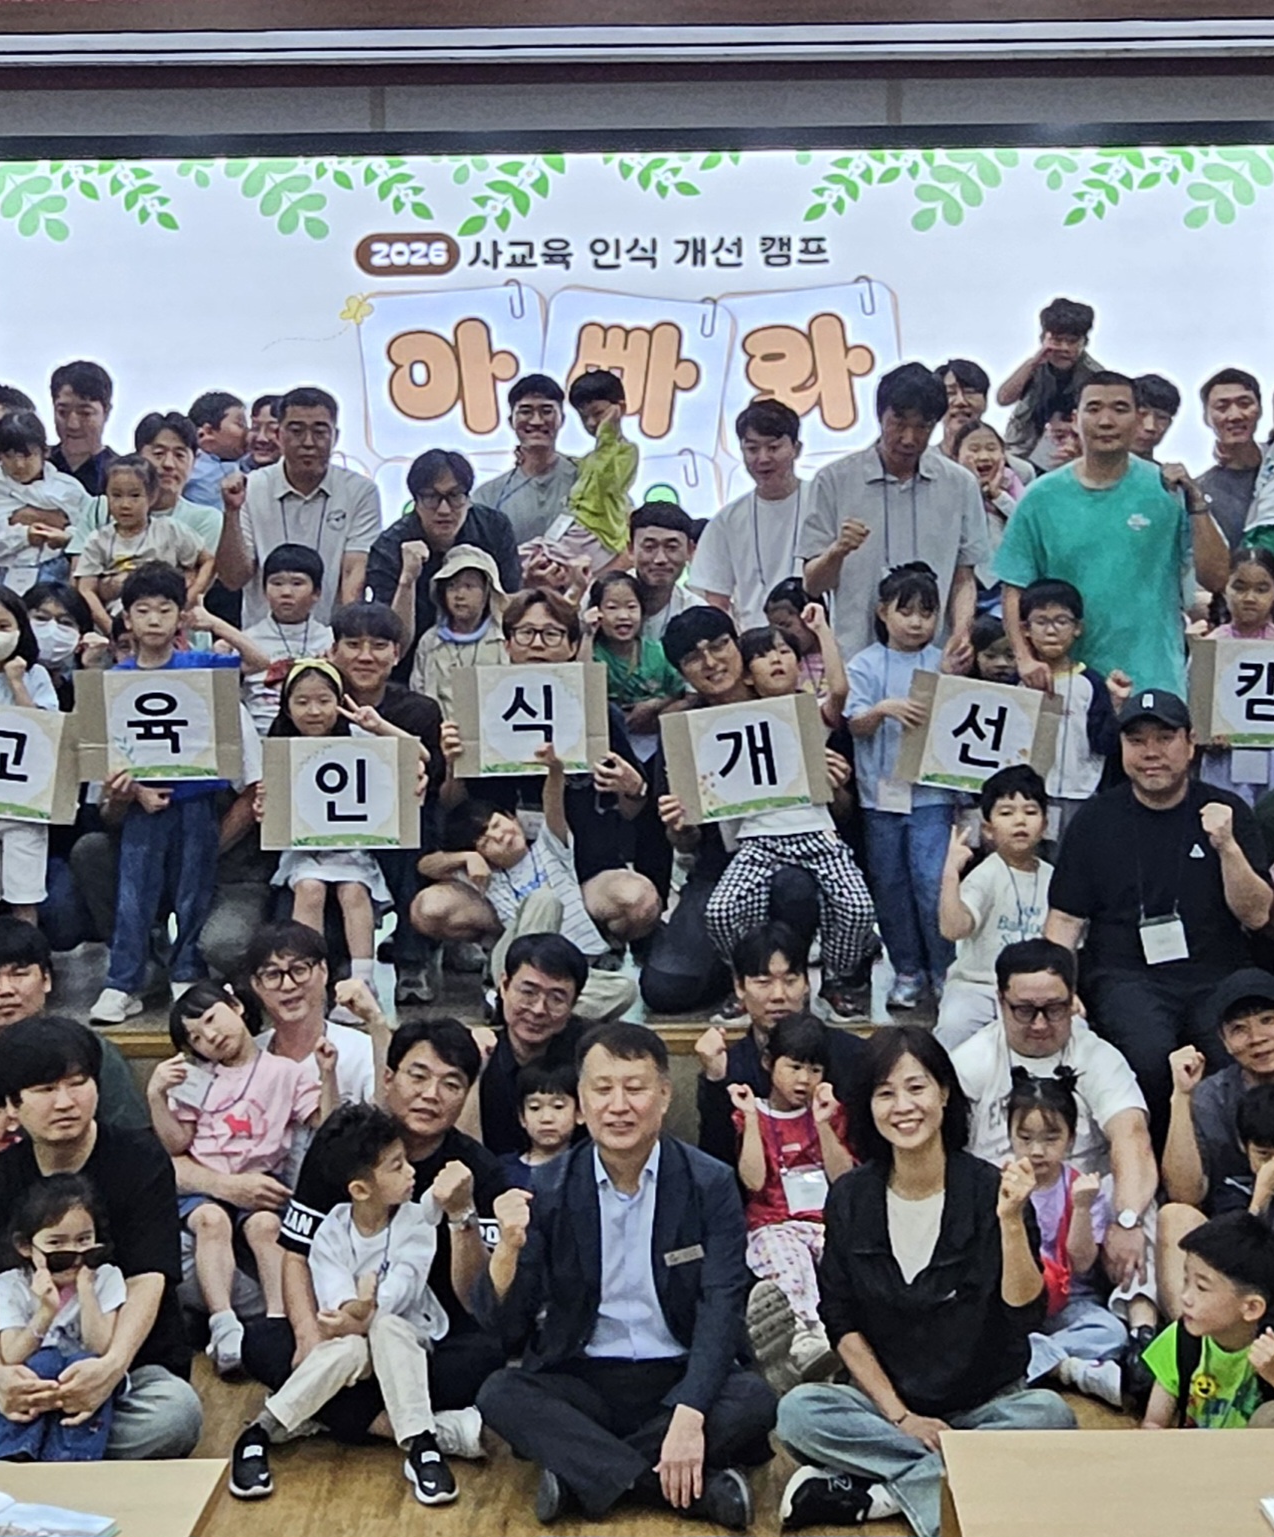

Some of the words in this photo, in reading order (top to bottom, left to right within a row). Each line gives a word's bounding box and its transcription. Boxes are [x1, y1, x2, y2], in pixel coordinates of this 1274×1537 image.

[369, 241, 449, 266] 2026
[468, 237, 573, 270] 사교육
[590, 238, 658, 270] 인식
[674, 237, 744, 269] 개선
[758, 236, 830, 268] 캠프
[126, 692, 188, 754] 육
[501, 684, 555, 744] 식
[952, 702, 1006, 769] 선
[716, 720, 778, 787] 개
[314, 758, 369, 823] 인
